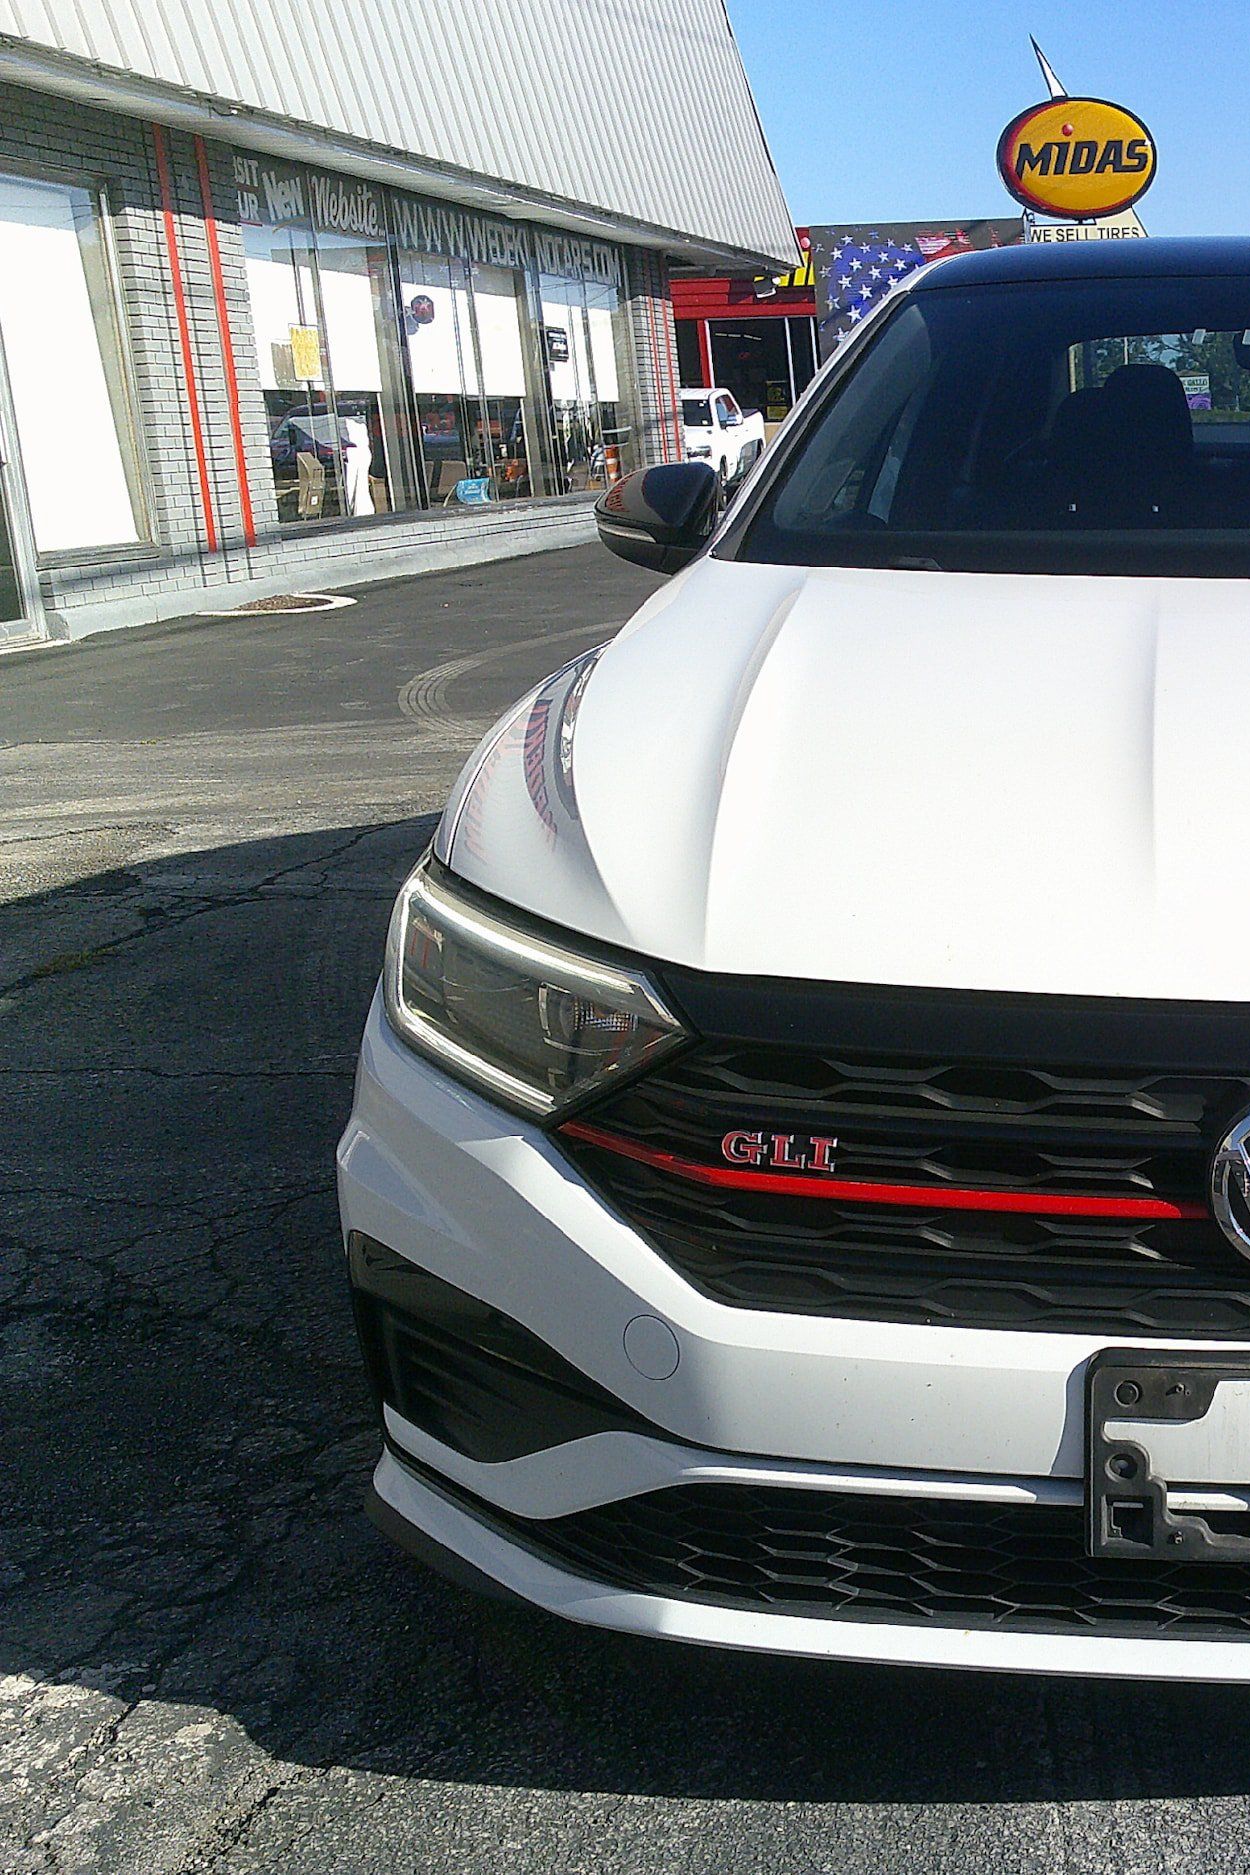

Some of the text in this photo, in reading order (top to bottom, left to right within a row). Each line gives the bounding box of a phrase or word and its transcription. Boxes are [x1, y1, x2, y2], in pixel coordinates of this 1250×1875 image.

[1015, 138, 1149, 181] MIDAS
[236, 190, 260, 220] UR
[1030, 227, 1139, 242] WE SELL TIRES
[721, 1130, 838, 1173] GLI
